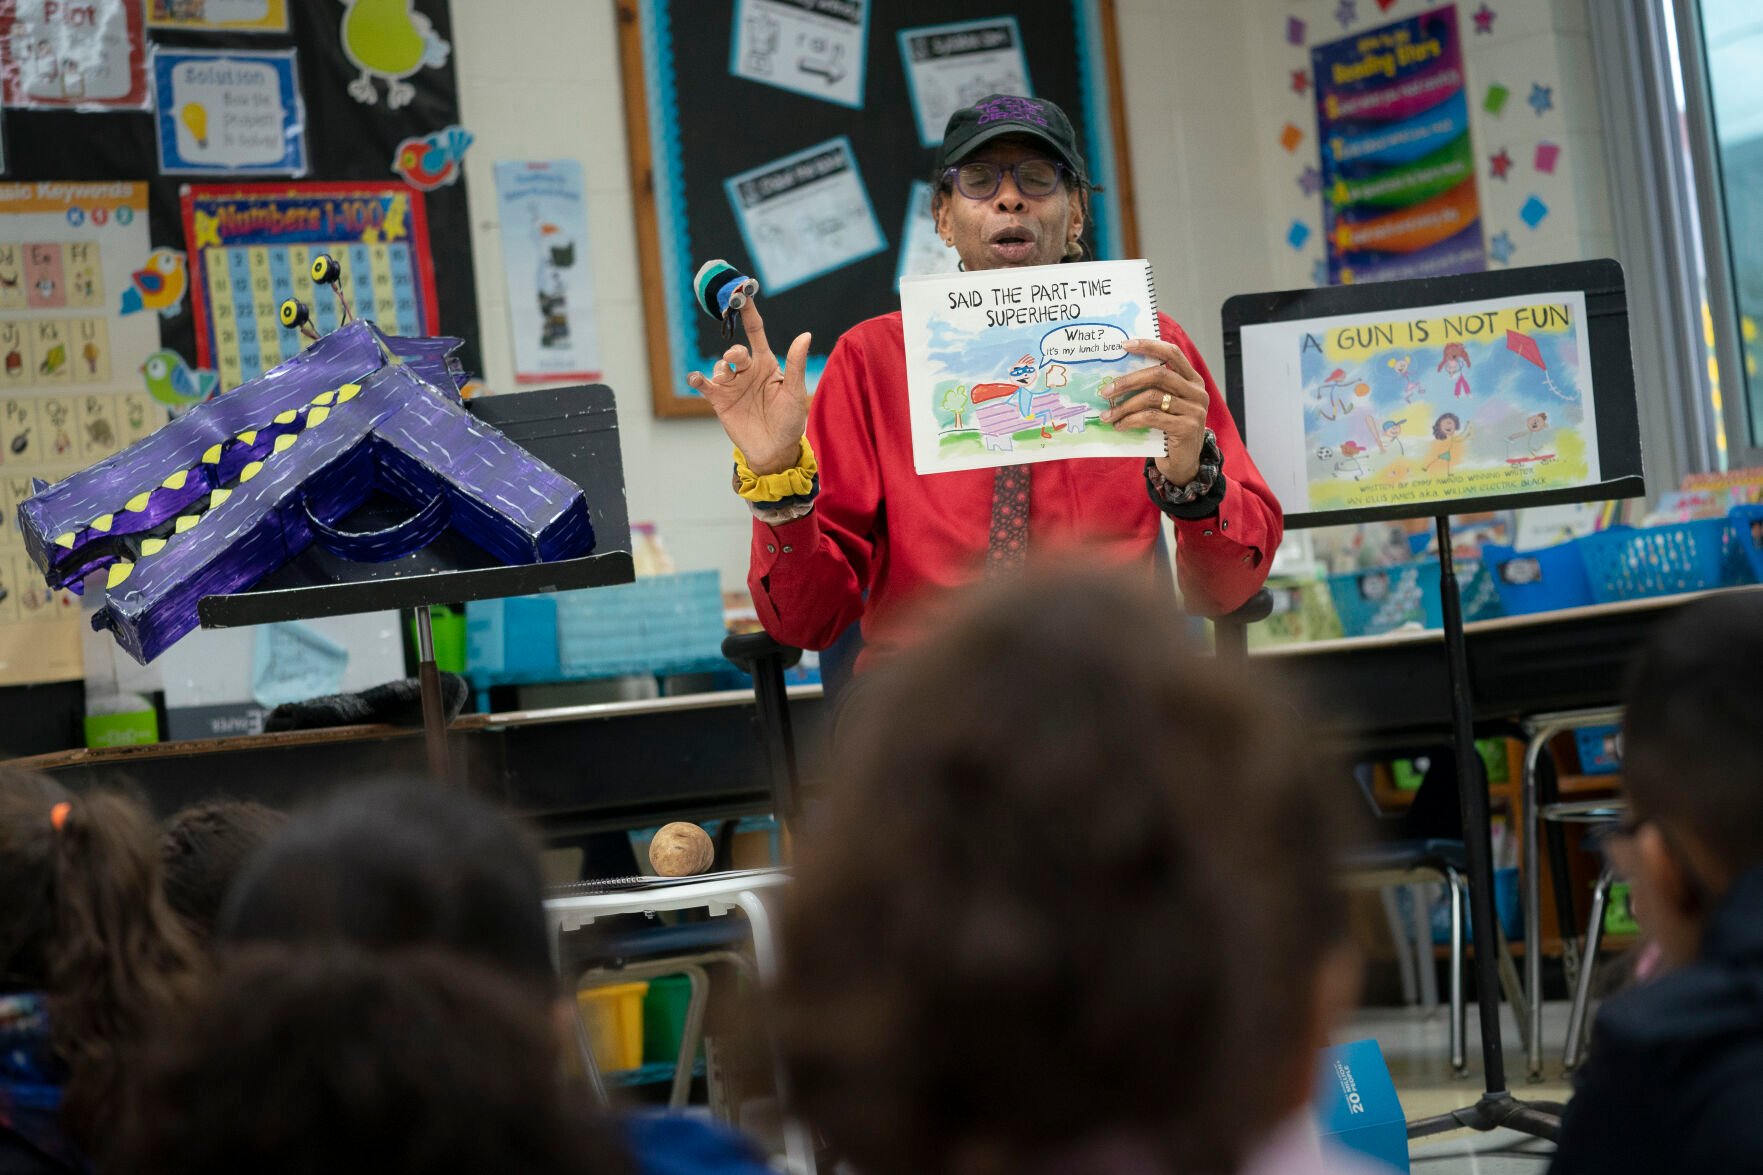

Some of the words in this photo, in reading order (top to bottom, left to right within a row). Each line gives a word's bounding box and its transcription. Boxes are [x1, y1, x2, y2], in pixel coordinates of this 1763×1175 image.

[184, 66, 264, 86] Solution
[36, 182, 133, 203] Keywords
[217, 203, 320, 237] Numbers
[325, 200, 384, 233] 1-100
[948, 290, 983, 309] SAID
[991, 287, 1022, 306] THE
[1031, 279, 1112, 303] PART-TIME
[986, 303, 1081, 327] SUPERHERO
[1064, 328, 1104, 341] What?
[1302, 333, 1323, 353] A
[1337, 323, 1394, 350] GUN
[1408, 320, 1429, 342] IS
[1443, 311, 1499, 339] NOT
[1515, 304, 1570, 330] FUN
[1063, 347, 1075, 356] my
[1079, 343, 1100, 354] lunch
[1521, 477, 1547, 488] BLACK
[1349, 1092, 1365, 1113] 20
